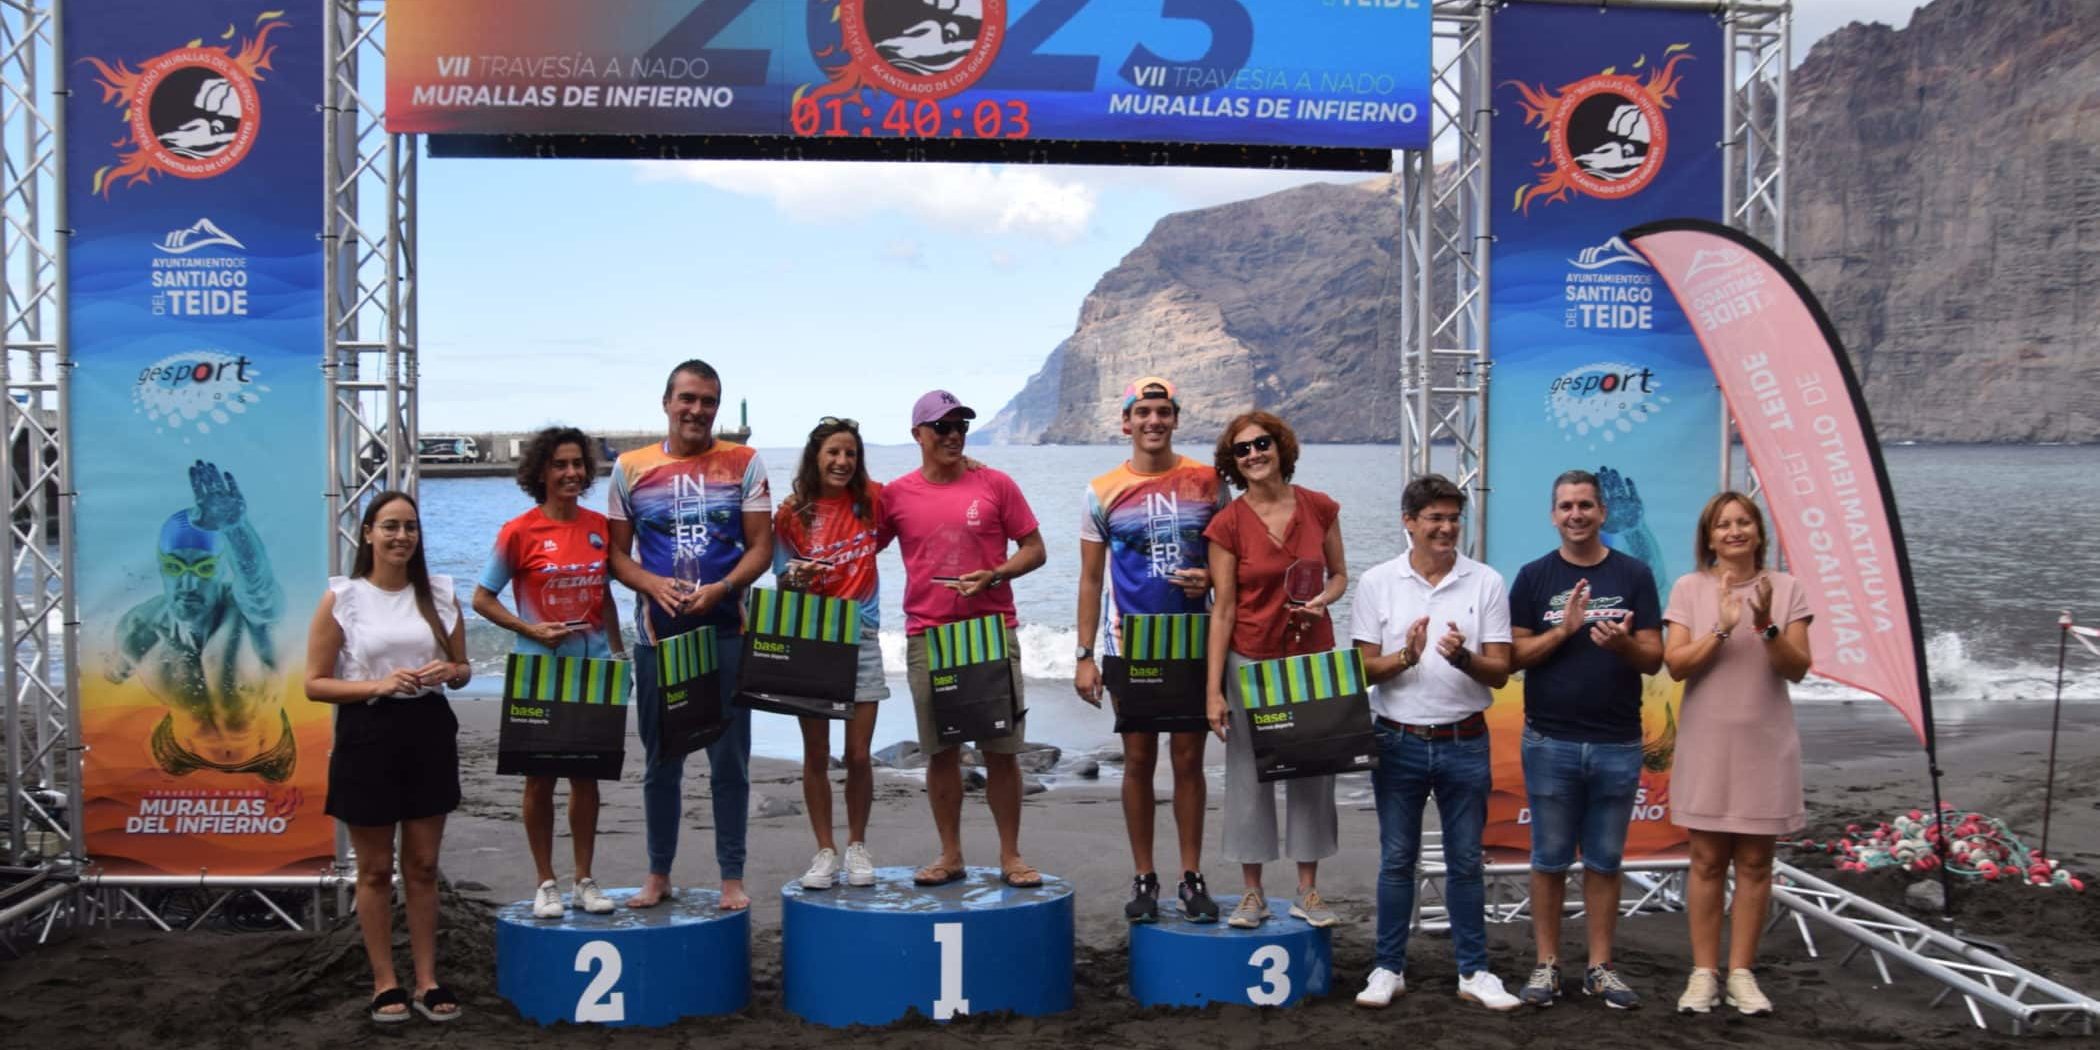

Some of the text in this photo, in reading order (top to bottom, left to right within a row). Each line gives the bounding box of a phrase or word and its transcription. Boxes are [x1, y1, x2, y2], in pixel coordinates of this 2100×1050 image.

[436, 53, 710, 79] VII TRAVESÍA A NADO
[935, 81, 949, 92] DE
[950, 70, 969, 86] LOS
[1132, 65, 1395, 95] VII TRAVESÍA A NADO
[411, 85, 734, 108] MURALLAS DE INFIERNO
[1108, 93, 1417, 124] MURALLAS DE INFIERNO
[791, 99, 1031, 139] 01:40:03
[152, 270, 247, 288] SANTIAGO
[152, 290, 247, 315] DEL TEIDE
[1566, 285, 1653, 303] SANTIAGO
[1565, 304, 1653, 329] DEL TEIDE
[137, 355, 252, 385] gesport
[1551, 368, 1654, 395] gesport
[139, 799, 265, 816] MURALLAS
[126, 817, 288, 834] DEL INFIERNO
[574, 940, 625, 1022] 2
[933, 922, 970, 1020] 1
[1246, 944, 1291, 1006] 3
